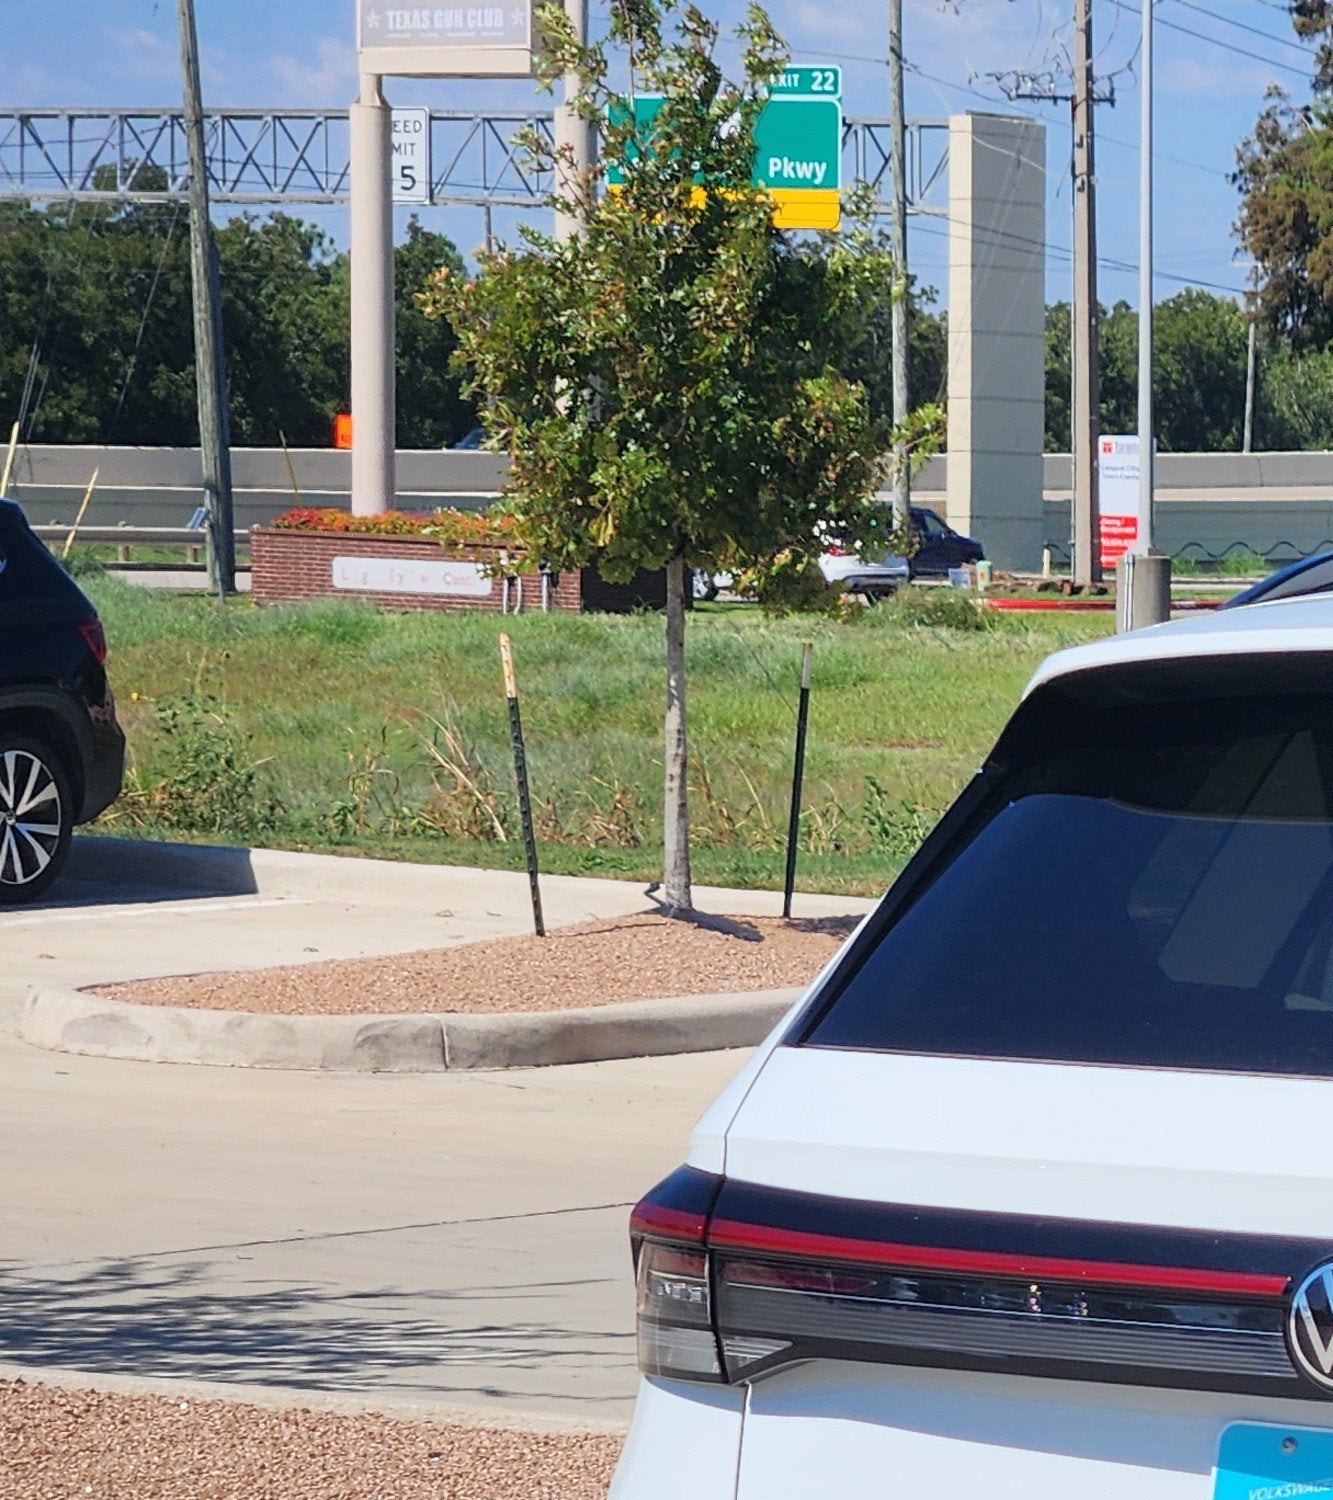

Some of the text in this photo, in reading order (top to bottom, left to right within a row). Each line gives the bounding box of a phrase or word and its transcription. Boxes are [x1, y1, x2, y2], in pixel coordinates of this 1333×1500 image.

[386, 8, 504, 31] TEXAS GUN CLUB
[811, 71, 834, 91] 22
[393, 120, 422, 134] EED
[392, 142, 417, 156] MIT
[400, 165, 416, 191] 5
[769, 156, 827, 185] Pkwy
